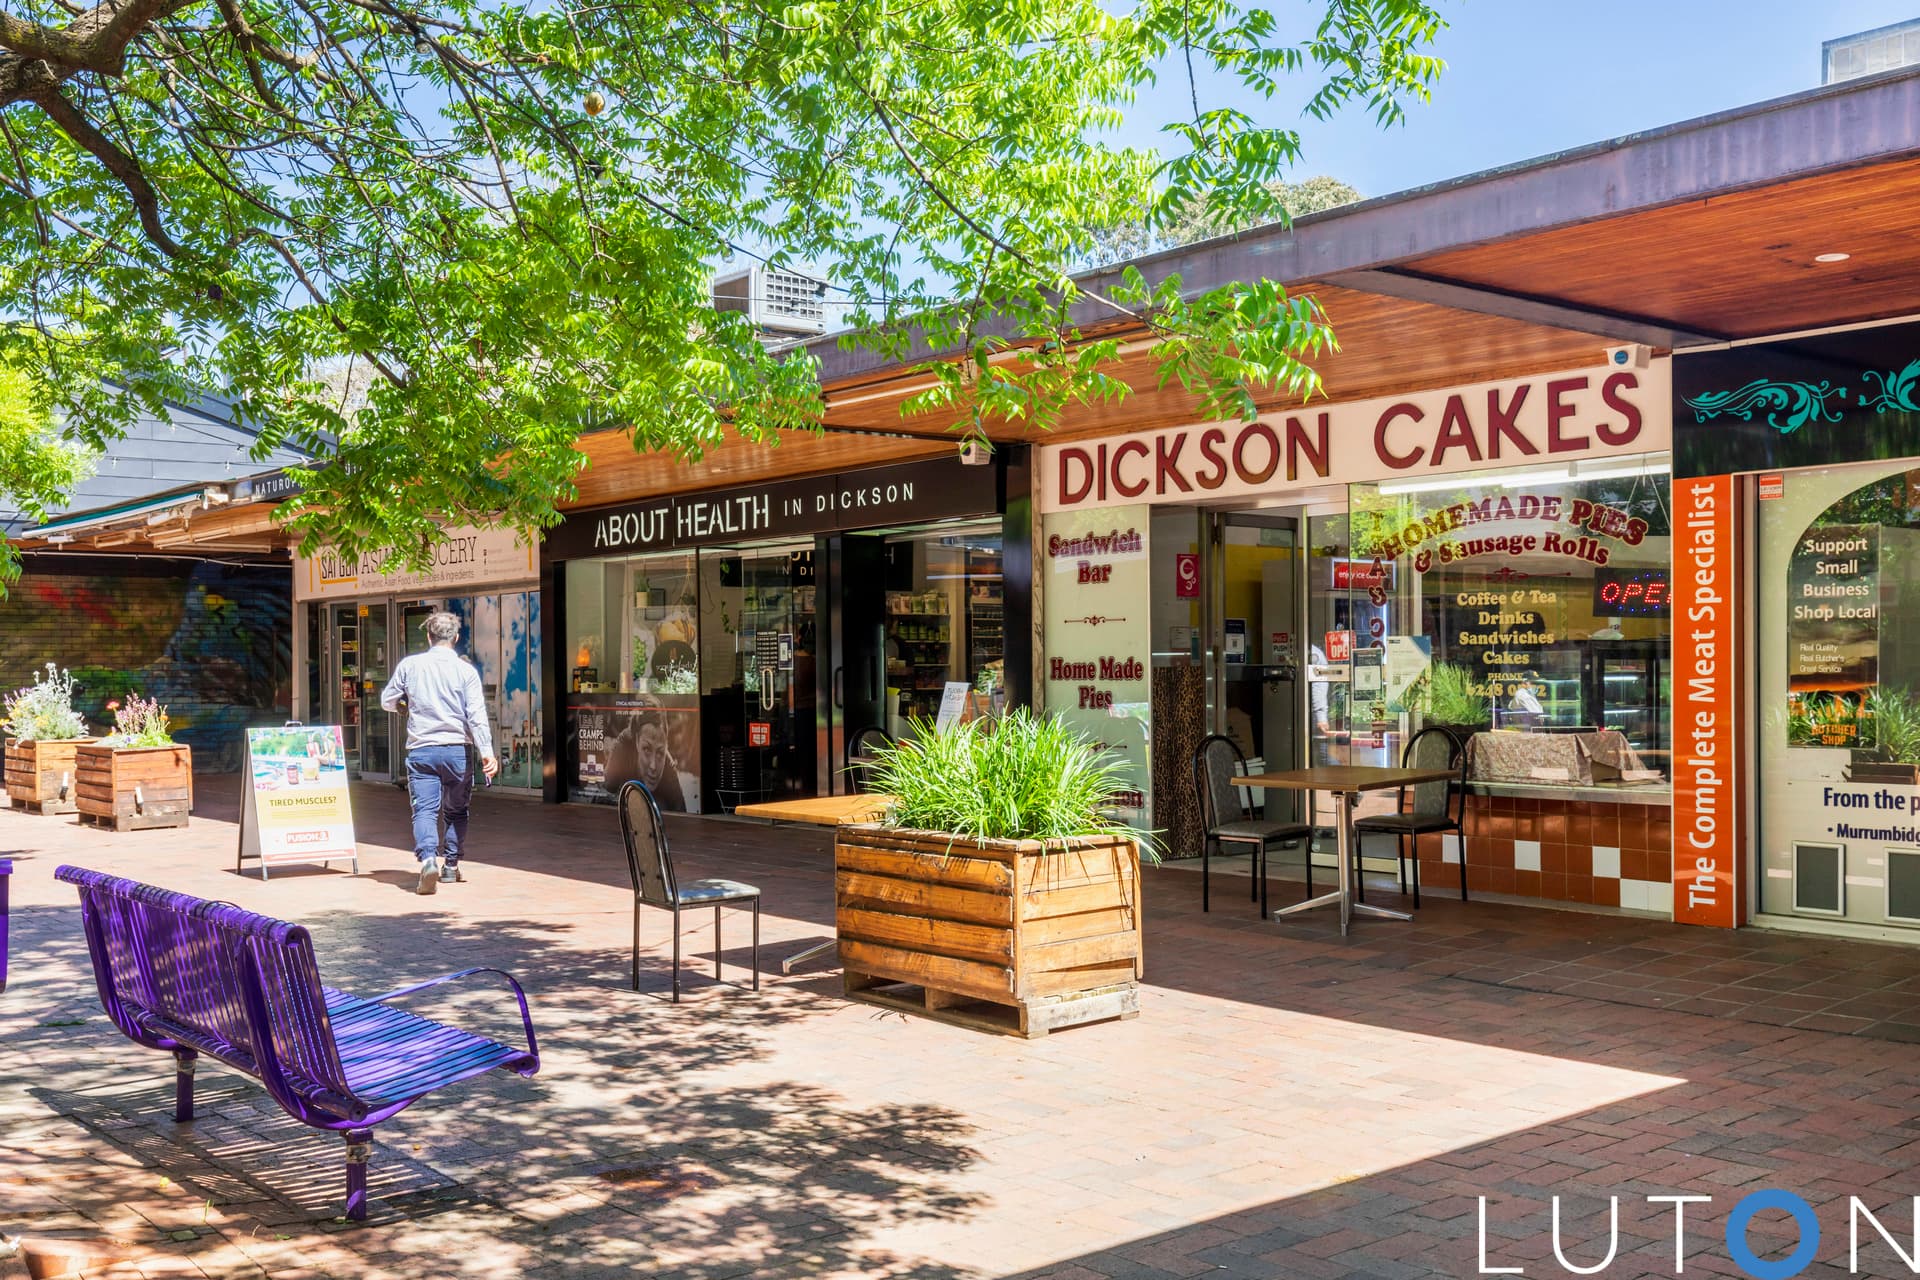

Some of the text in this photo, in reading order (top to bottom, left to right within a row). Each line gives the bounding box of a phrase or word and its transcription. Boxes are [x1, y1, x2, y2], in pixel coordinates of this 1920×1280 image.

[1059, 371, 1642, 505] DICKSON CAKES
[595, 482, 914, 548] ABOUT HEALTH IN DICKSON
[1382, 495, 1649, 561] HOMEMADE PIES
[1048, 528, 1143, 557] Sandwich
[1806, 538, 1868, 556] Support
[1414, 531, 1610, 573] & Sausage Rolls
[1077, 559, 1112, 584] Bar
[1816, 559, 1858, 575] Small
[1457, 589, 1557, 606] Coffee & Tea
[1803, 583, 1870, 597] Business
[1478, 611, 1535, 625] Drinks
[1794, 603, 1876, 622] Shop Local
[1459, 630, 1555, 645] Sandwiches
[1799, 643, 1839, 653] Real Quality
[1482, 650, 1531, 664] Cakes
[1799, 654, 1845, 663] Real Butcher's
[1050, 656, 1144, 681] Home Made
[1799, 664, 1842, 673] Great Service
[1488, 673, 1524, 681] PHONE
[1078, 685, 1113, 709] Pies
[1688, 482, 1722, 909] The Complete Meat Specialist
[579, 729, 604, 739] CRAMPS
[1821, 734, 1847, 745] SHOP
[579, 739, 604, 751] BEHIND
[270, 795, 337, 807] TIRED MUSCLES?
[1824, 787, 1869, 808] From
[1874, 789, 1906, 810] the
